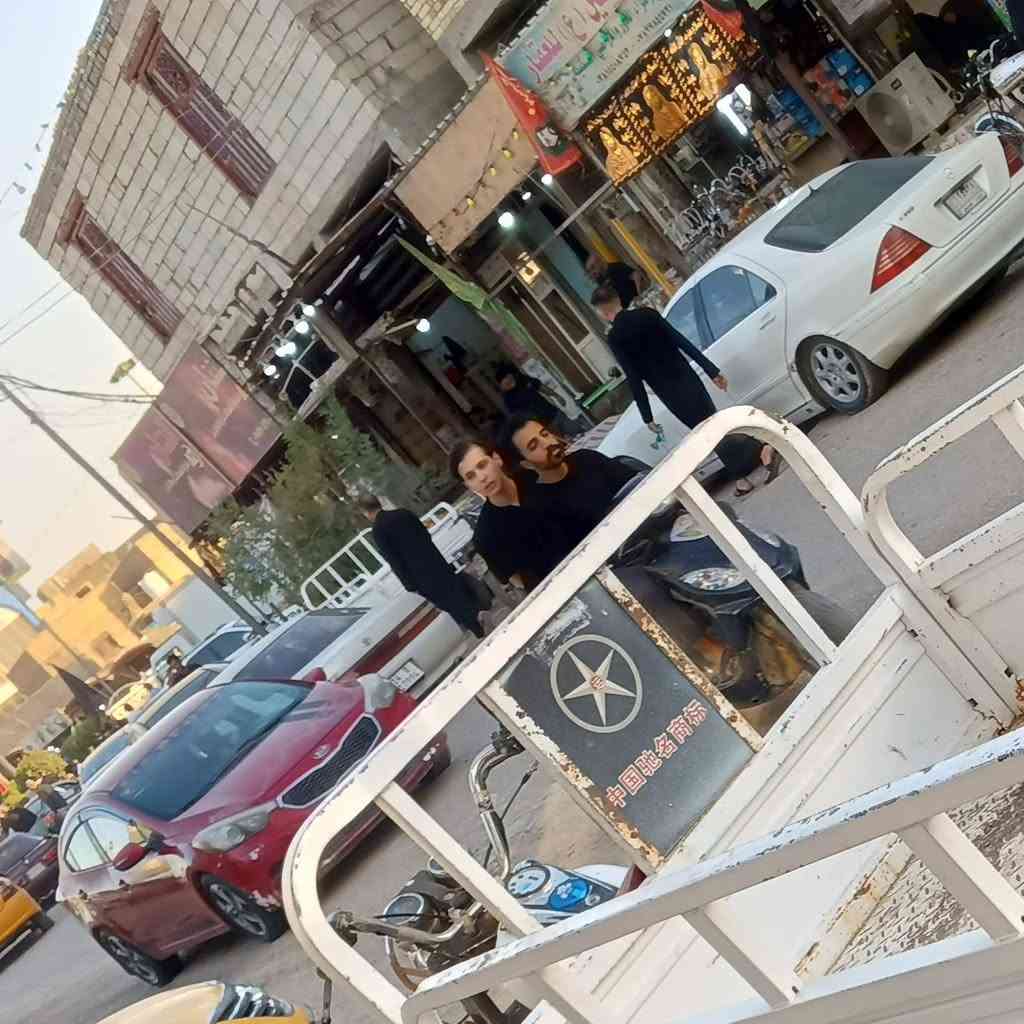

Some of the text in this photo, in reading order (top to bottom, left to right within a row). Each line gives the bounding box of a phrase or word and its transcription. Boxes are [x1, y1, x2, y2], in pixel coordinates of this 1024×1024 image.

[606, 699, 707, 808] 中国驰名商标
